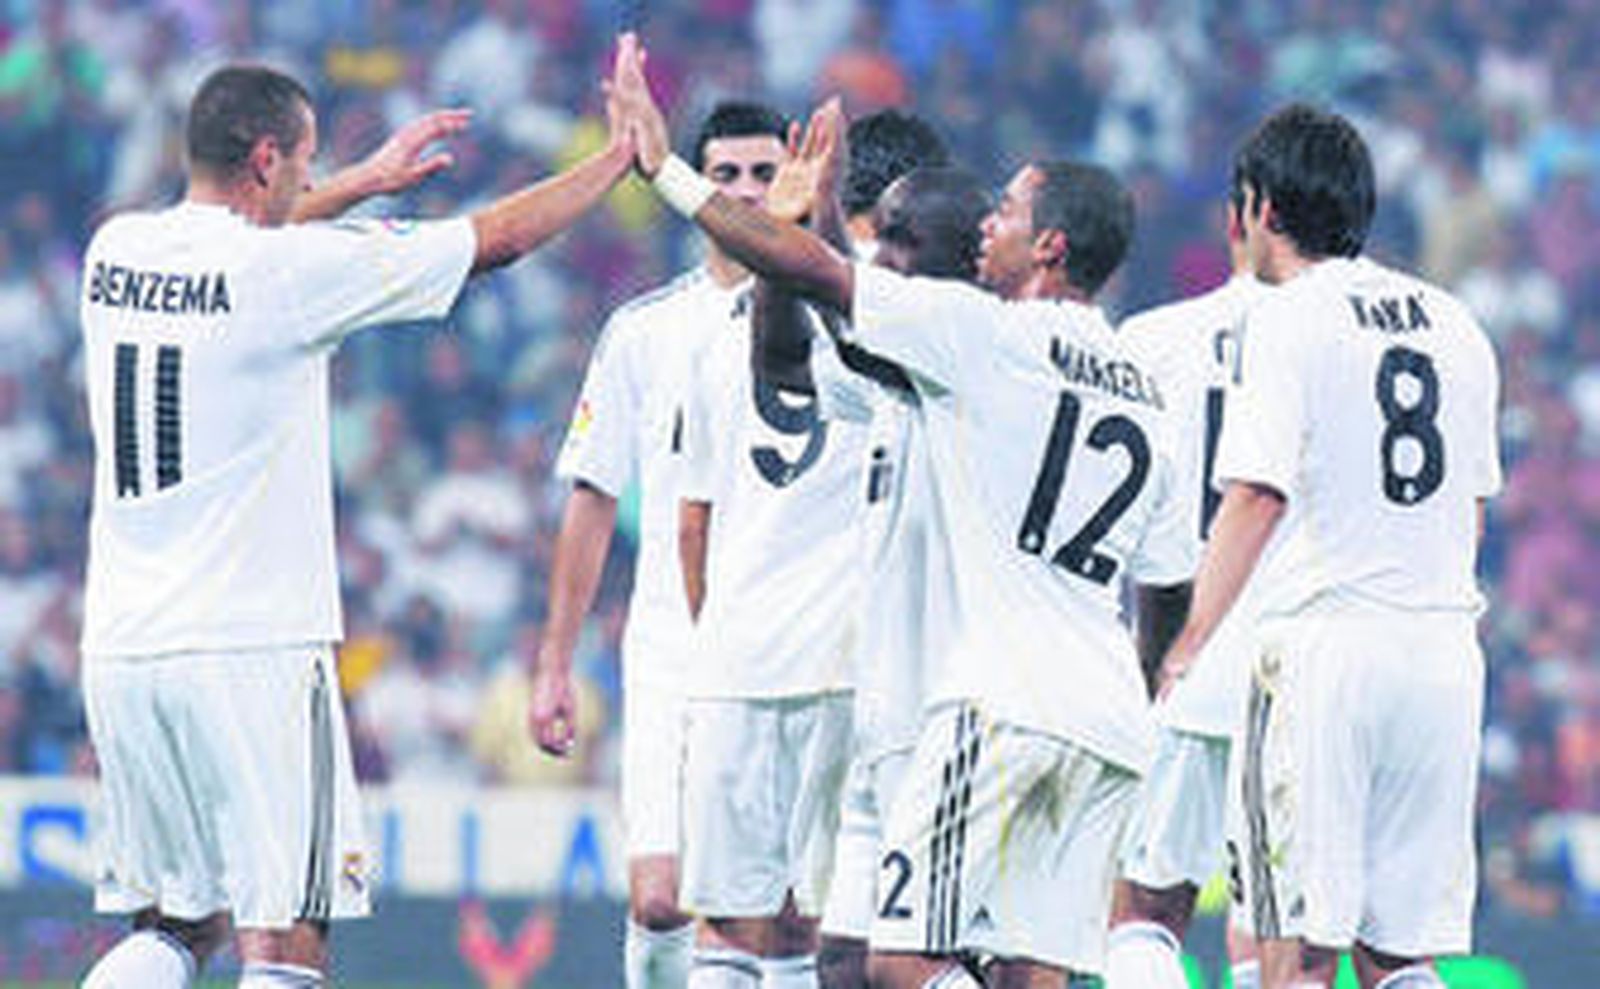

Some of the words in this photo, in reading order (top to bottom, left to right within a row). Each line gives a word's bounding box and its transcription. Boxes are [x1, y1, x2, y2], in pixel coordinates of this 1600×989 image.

[90, 260, 230, 314] BENZEMA
[114, 343, 183, 498] 11
[1017, 389, 1152, 587] 12
[1375, 344, 1445, 506] 8
[879, 850, 913, 919] 2
